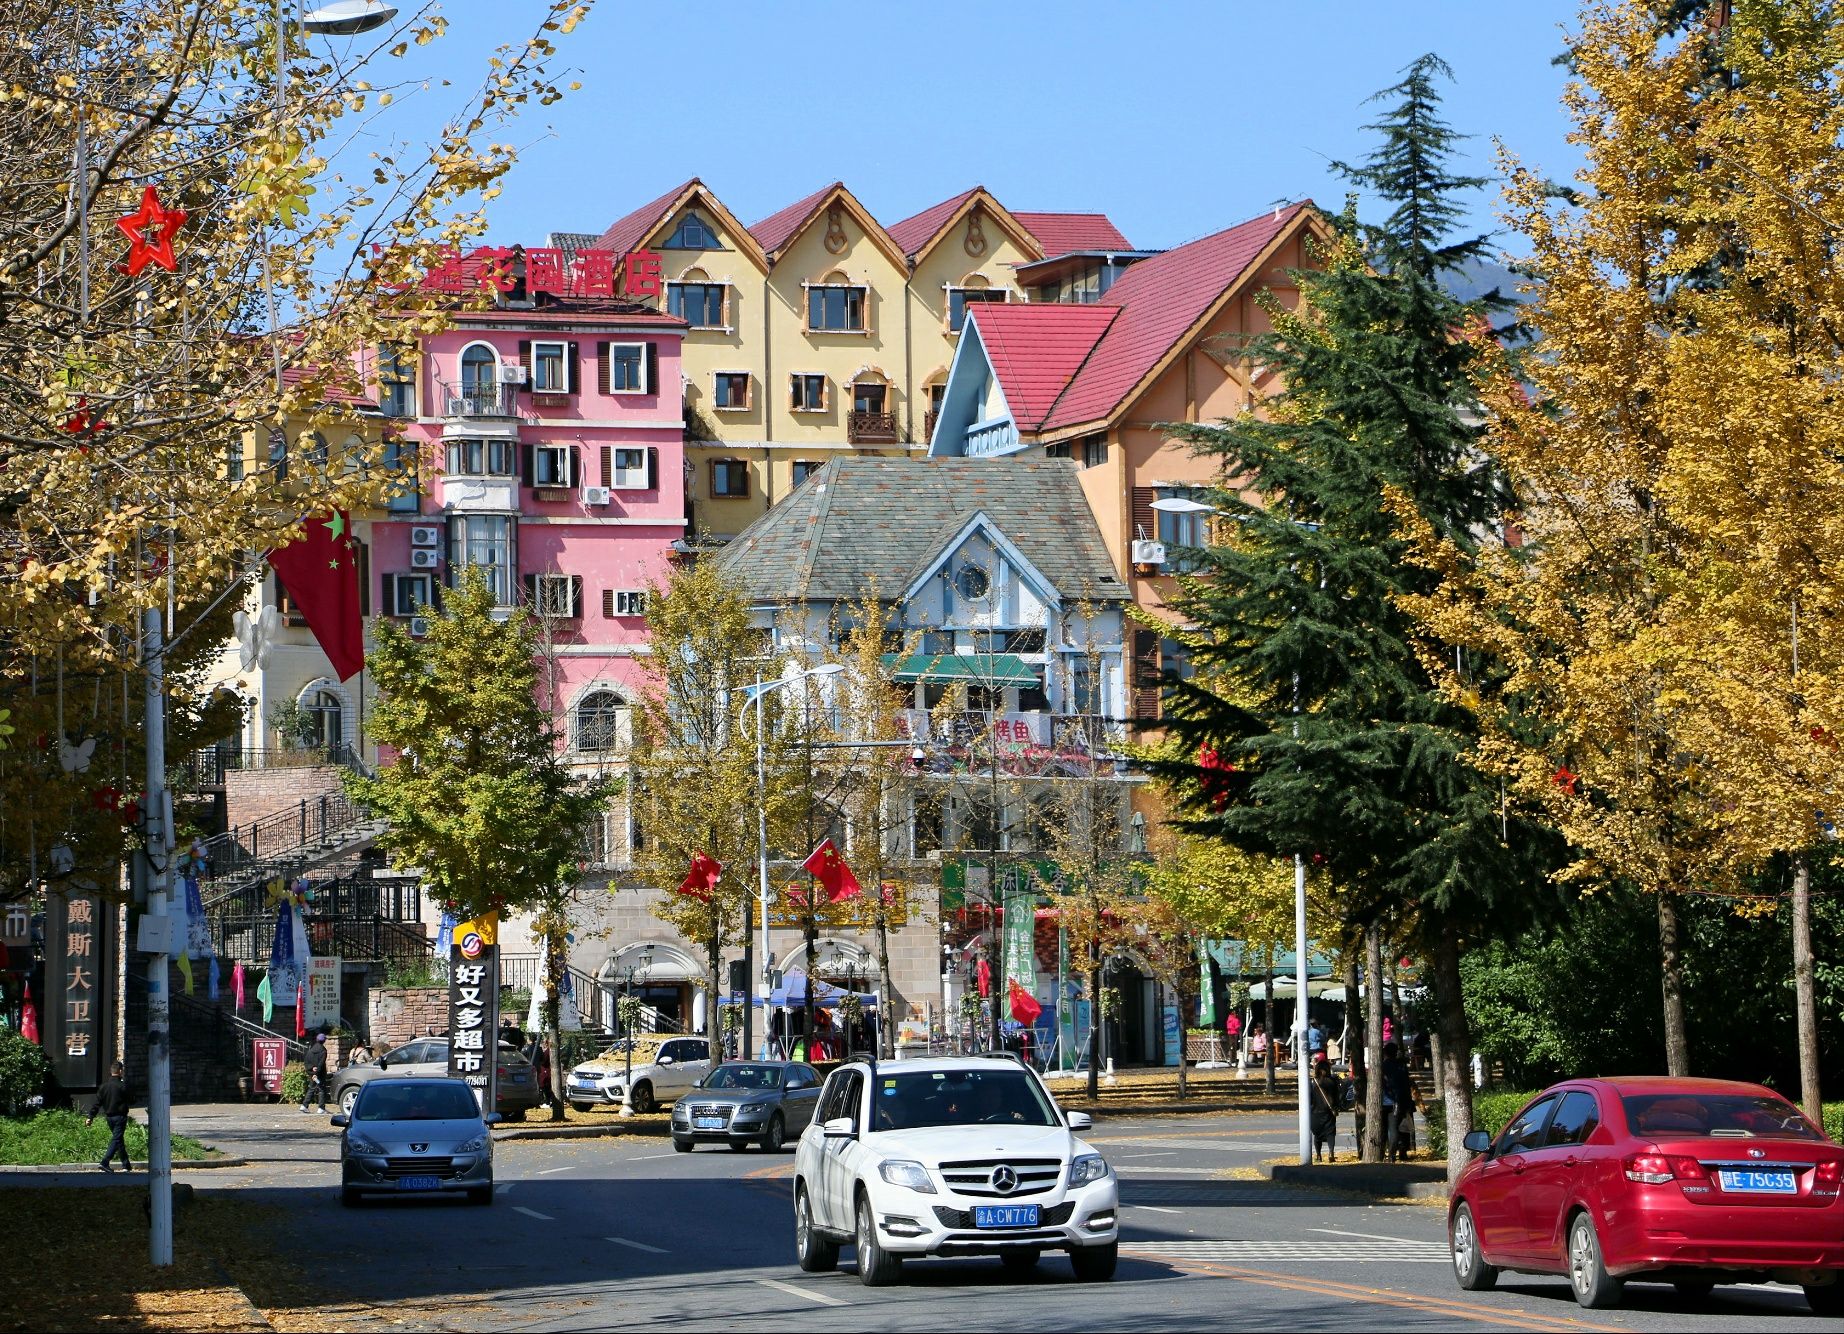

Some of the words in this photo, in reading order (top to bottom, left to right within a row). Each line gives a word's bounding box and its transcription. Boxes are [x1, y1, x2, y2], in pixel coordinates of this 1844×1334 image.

[66, 899, 92, 1056] 戴斯大卫营
[454, 965, 486, 1072] 好又多超市
